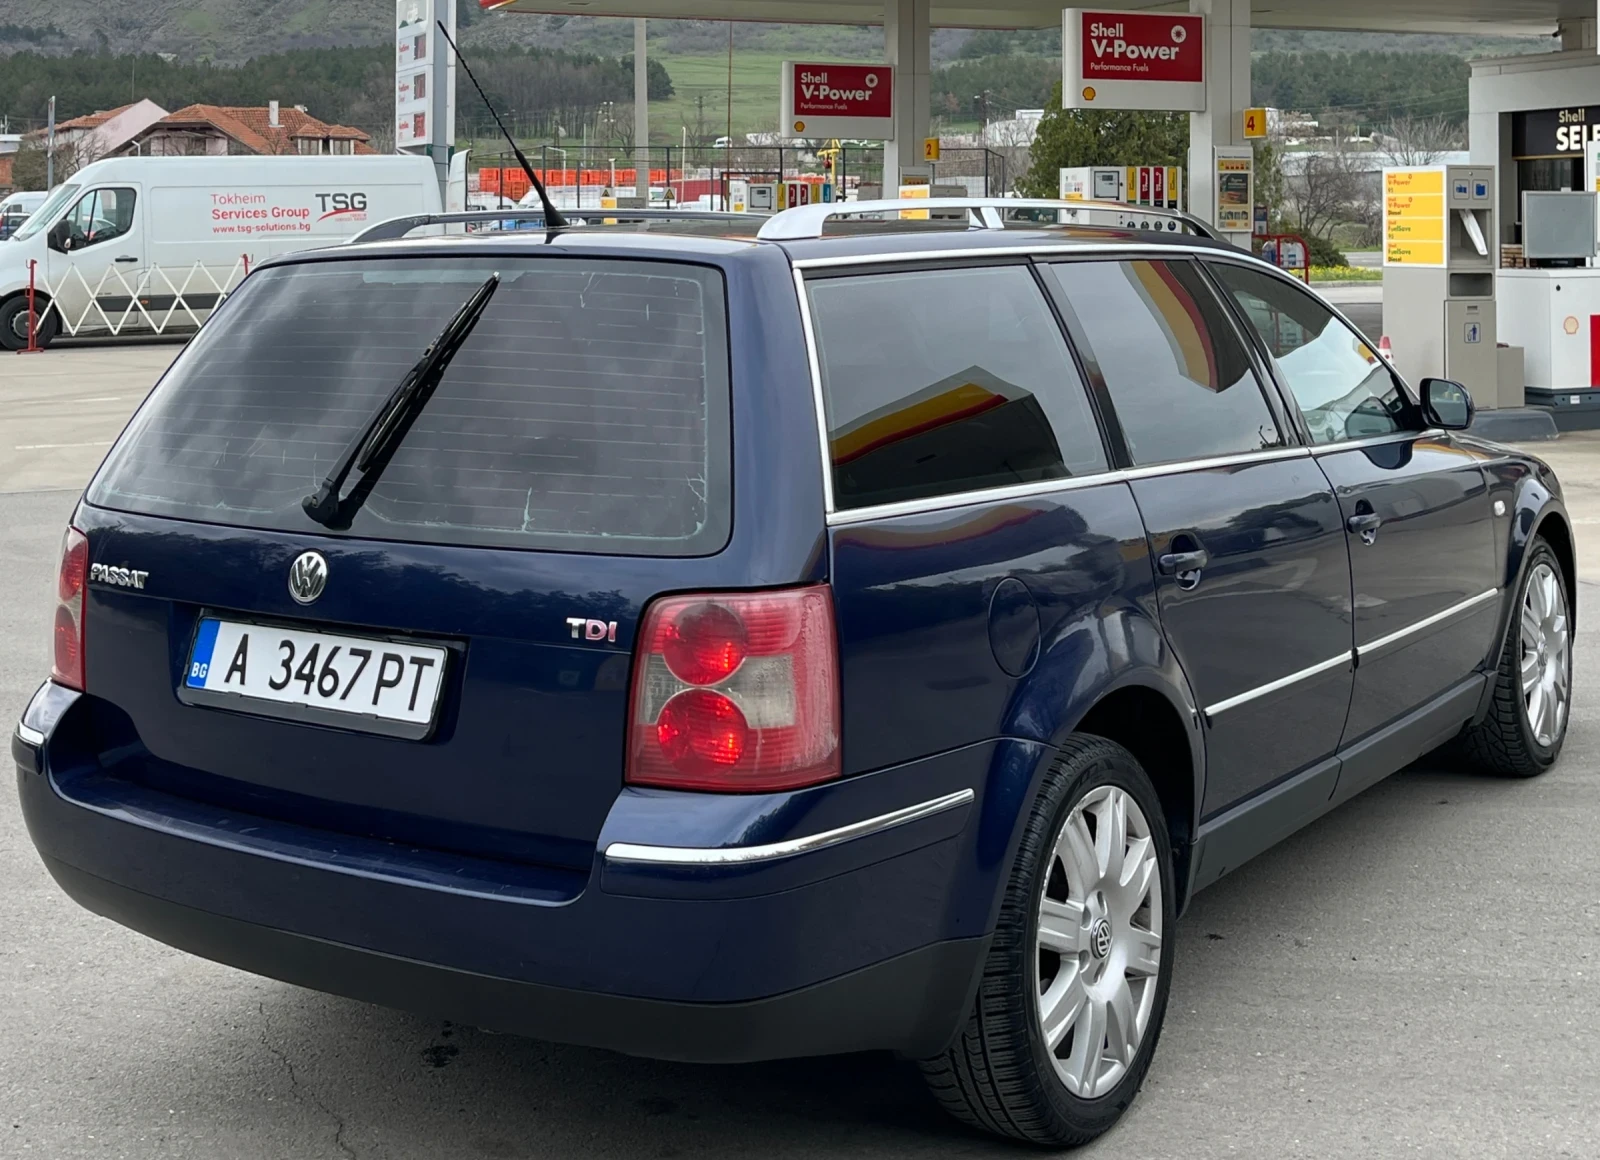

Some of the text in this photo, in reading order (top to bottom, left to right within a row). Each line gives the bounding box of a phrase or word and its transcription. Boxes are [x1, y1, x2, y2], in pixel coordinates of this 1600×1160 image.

[1090, 22, 1124, 37] Shell
[1091, 38, 1180, 60] V-Power
[1090, 62, 1149, 72] Performance Fuels
[801, 72, 828, 84] Shell
[801, 84, 872, 101] V-Power
[800, 102, 834, 110] Performance
[1246, 115, 1256, 131] 4
[1558, 108, 1585, 123] Shell
[926, 143, 932, 155] 2
[210, 193, 266, 205] Tokheim
[315, 192, 367, 213] TSG
[212, 206, 310, 220] Services Group
[212, 222, 311, 234] www.tsg-solutions.bg
[90, 562, 149, 590] PASSAT
[566, 617, 618, 643] TDI
[224, 632, 250, 686] A
[190, 661, 208, 679] BG
